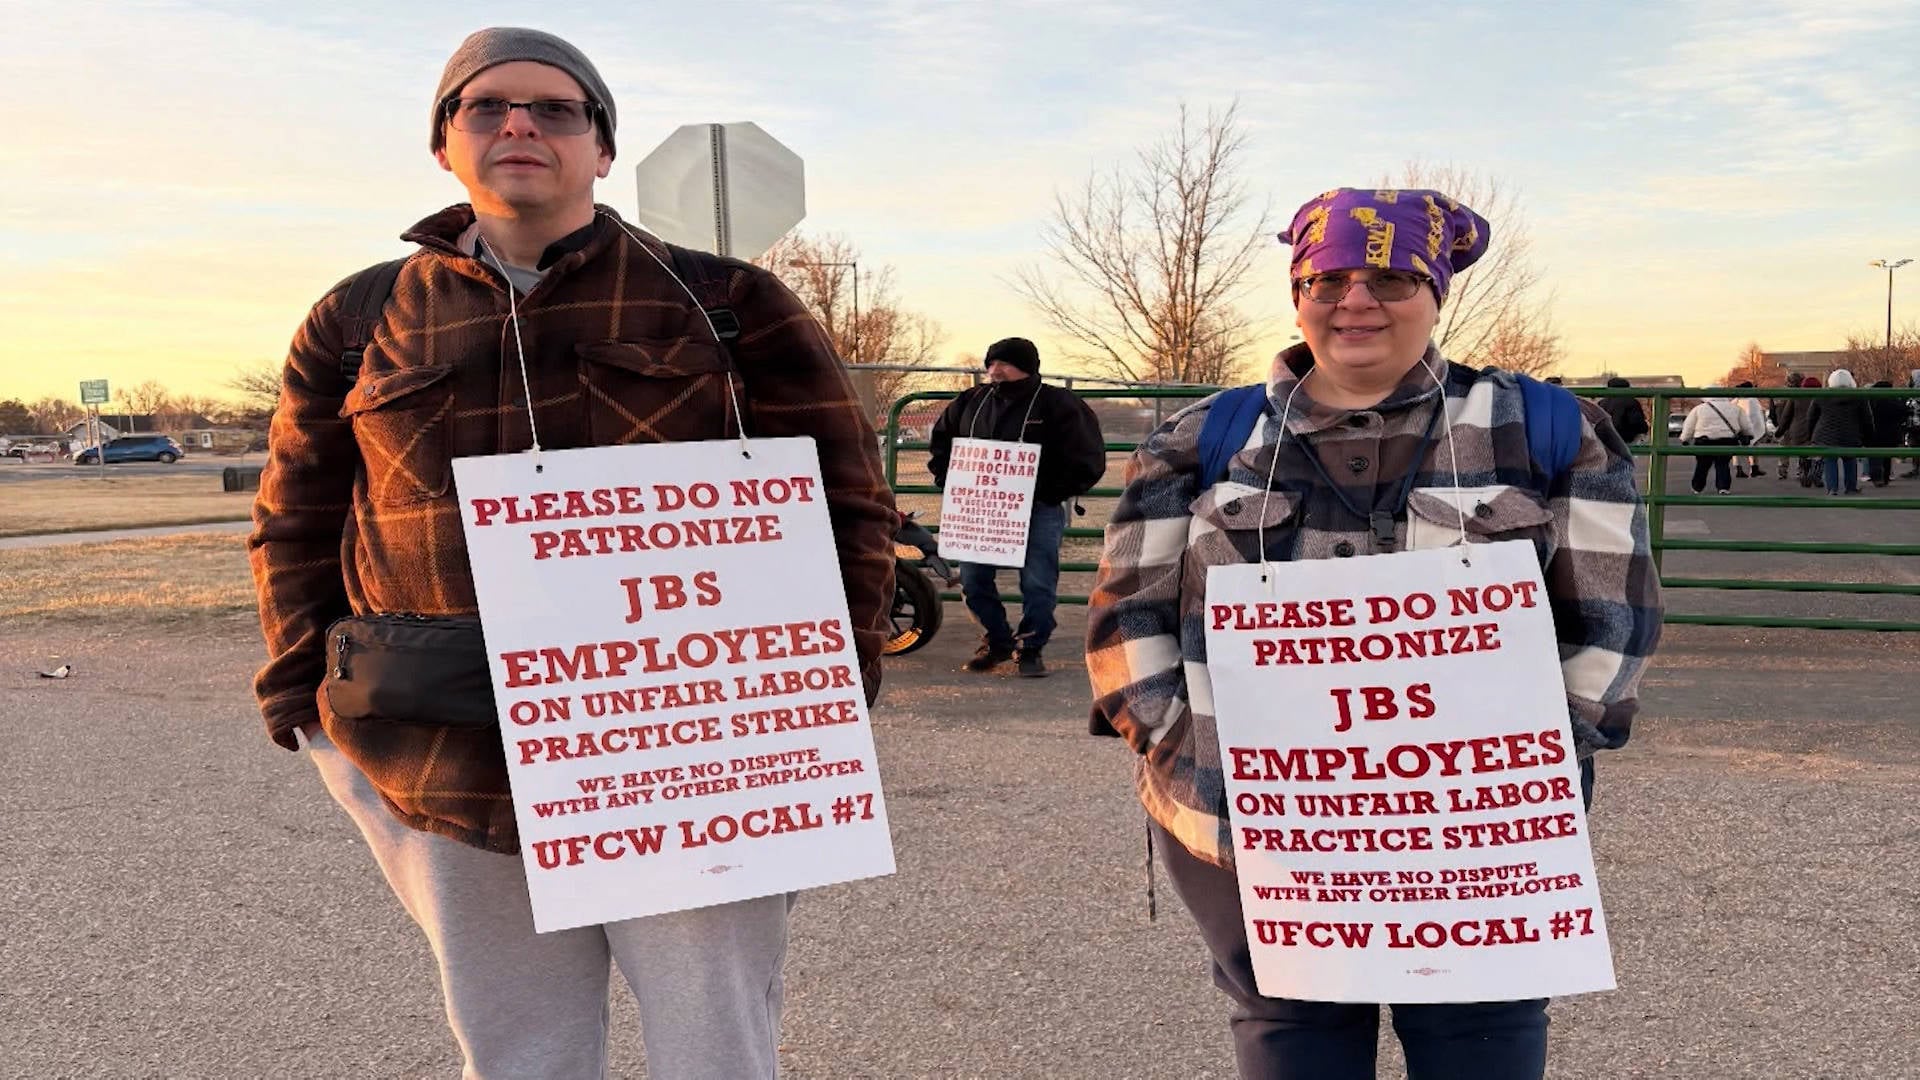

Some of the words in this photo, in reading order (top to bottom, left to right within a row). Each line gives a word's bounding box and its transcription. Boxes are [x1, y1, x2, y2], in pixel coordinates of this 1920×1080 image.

[994, 449, 1012, 462] DE
[1018, 452, 1037, 463] NO
[470, 486, 644, 527] PLEASE
[653, 482, 719, 512] DO
[729, 475, 813, 507] NOT
[950, 487, 1025, 502] EMPLEADOS
[531, 515, 781, 560] PATRONIZE
[974, 544, 1008, 555] LOCAL
[620, 572, 721, 624] JBS
[1213, 599, 1355, 632] PLEASE
[1364, 592, 1436, 624] DO
[1447, 581, 1536, 616] NOT
[501, 619, 845, 688] EMPLOYEES
[1253, 622, 1501, 667] PATRONIZE
[508, 696, 570, 726] ON
[581, 680, 726, 717] UNFAIR
[735, 665, 856, 700] LABOR
[1329, 683, 1435, 733] JBS
[517, 717, 721, 765] PRACTICE
[730, 700, 858, 737] STRIKE
[577, 776, 617, 793] WE
[623, 767, 684, 789] HAVE
[689, 762, 724, 779] NO
[729, 749, 820, 772] DISPUTE
[1230, 730, 1565, 782] EMPLOYEES
[532, 795, 599, 818] WITH
[606, 788, 654, 810] ANY
[661, 776, 739, 800] OTHER
[745, 760, 864, 789] EMPLOYER
[1236, 792, 1284, 816] ON
[1294, 790, 1438, 817] UNFAIR
[1446, 776, 1574, 813] LABOR
[531, 824, 666, 870] UFCW
[678, 802, 823, 849] LOCAL
[832, 792, 873, 823] #7
[1240, 826, 1432, 853] PRACTICE
[1441, 812, 1577, 849] STRIKE
[1253, 886, 1312, 901] WITH
[1317, 889, 1361, 902] ANY
[1368, 886, 1449, 902] OTHER
[1456, 873, 1583, 898] EMPLOYER
[1290, 871, 1325, 885] WE
[1331, 871, 1392, 885] HAVE
[1397, 870, 1434, 884] NO
[1440, 863, 1539, 884] DISPUTE
[1252, 918, 1373, 949] UFCW
[1384, 916, 1540, 949] LOCAL
[1549, 908, 1593, 939] #7
